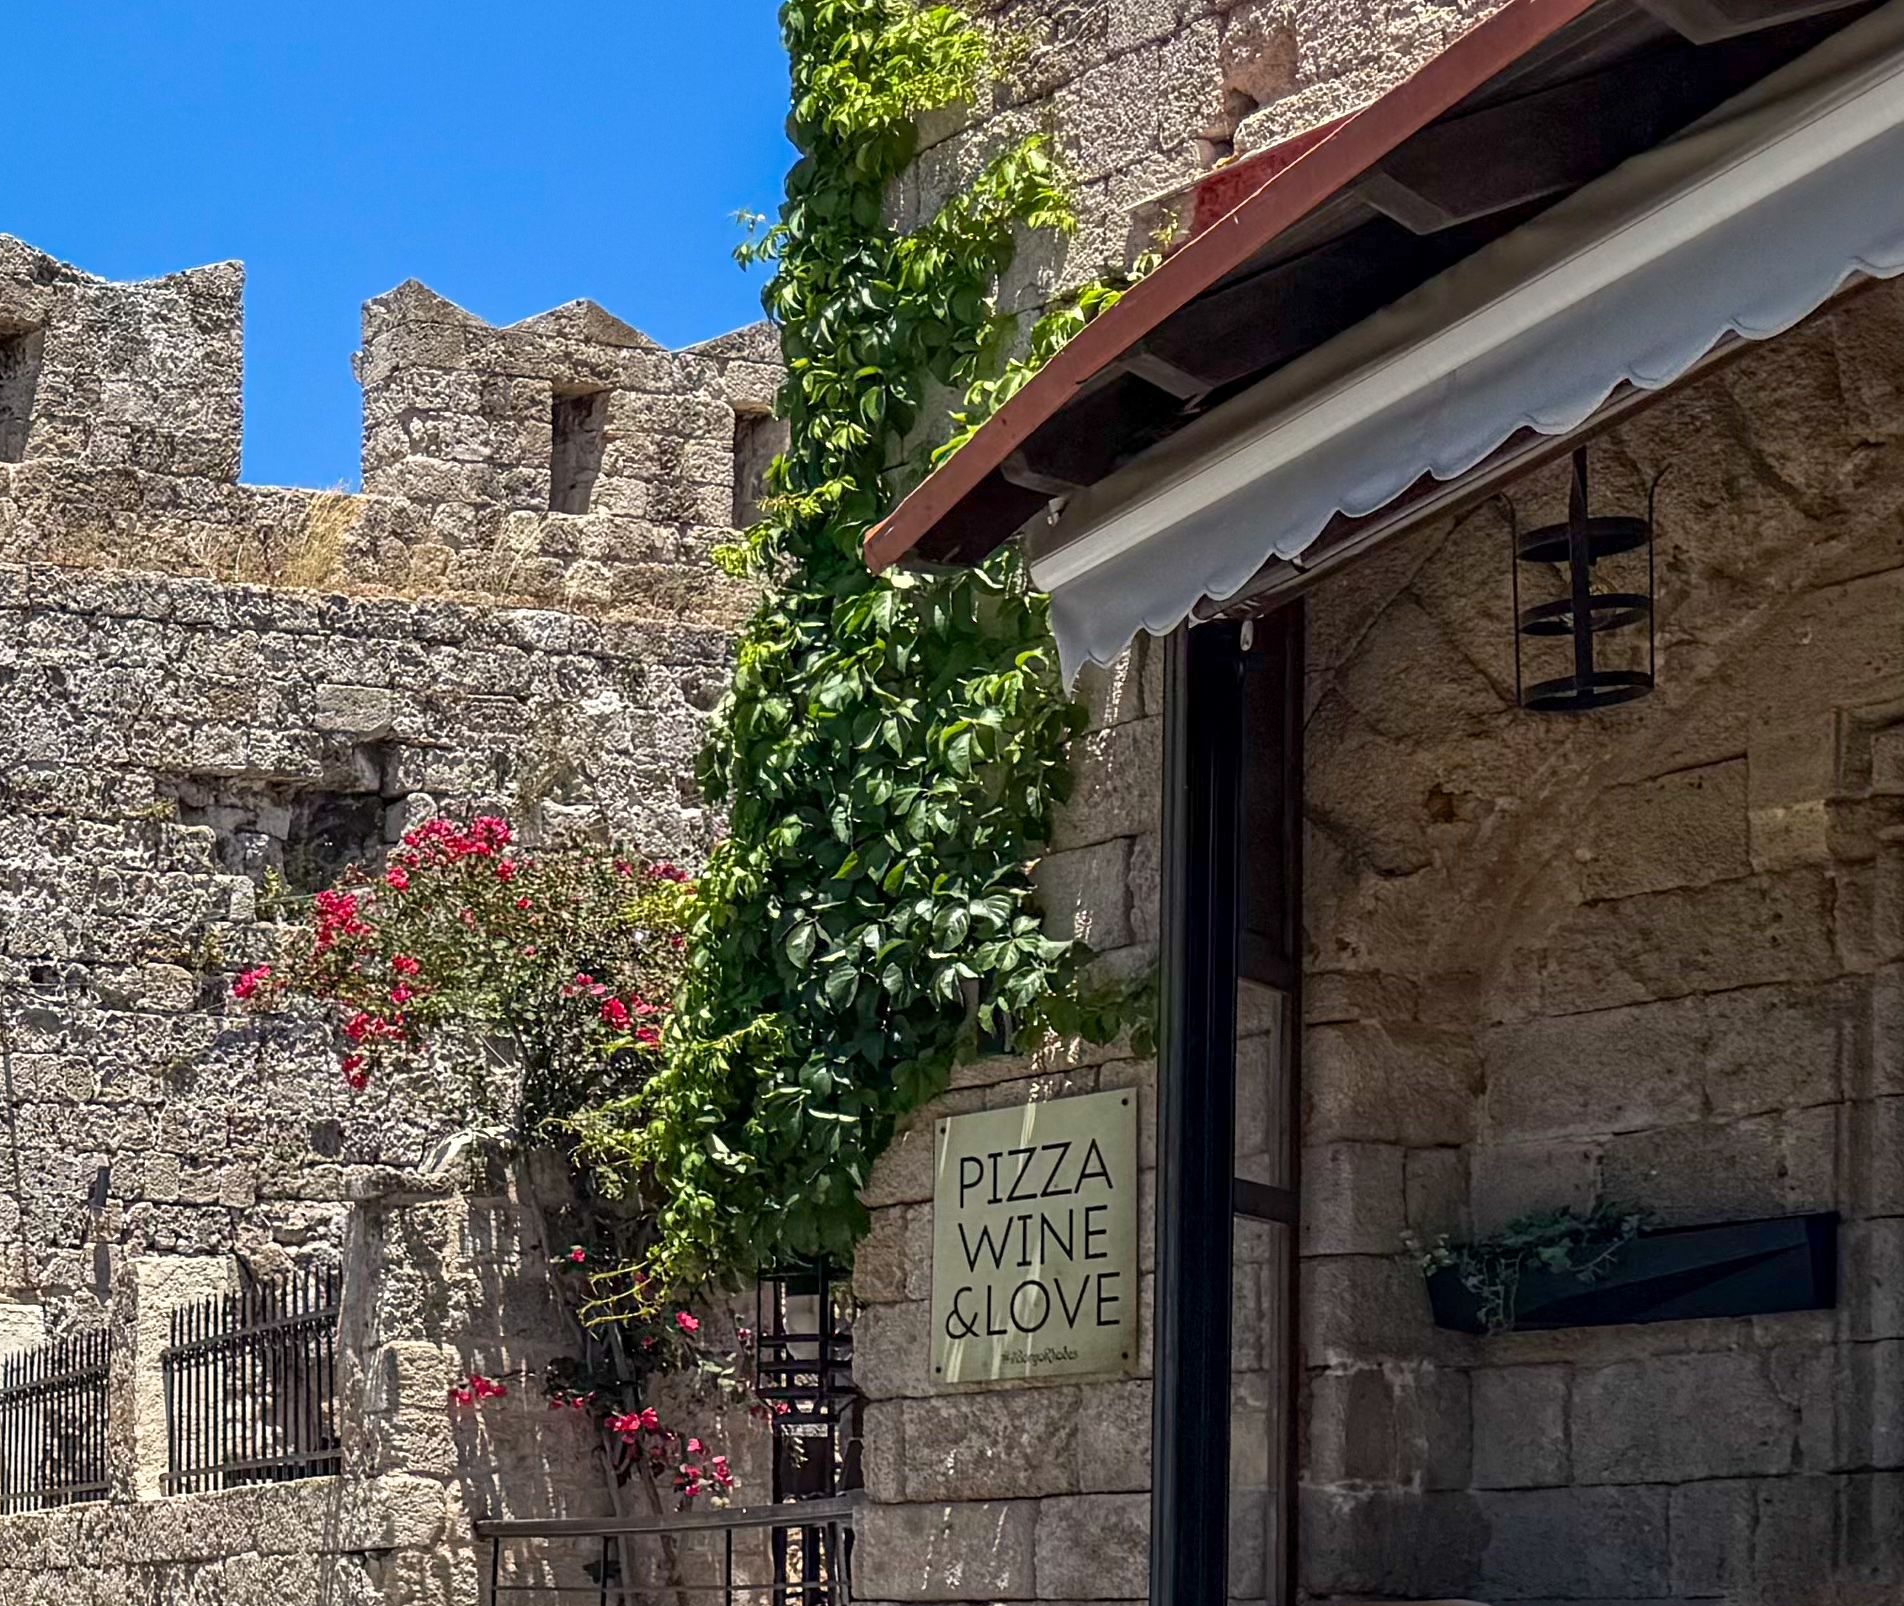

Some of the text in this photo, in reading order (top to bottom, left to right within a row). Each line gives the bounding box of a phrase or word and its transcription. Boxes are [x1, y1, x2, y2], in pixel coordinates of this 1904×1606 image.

[959, 1138, 1113, 1209] PIZZA
[958, 1204, 1108, 1273] WINE
[945, 1271, 1121, 1340] &LOVE
